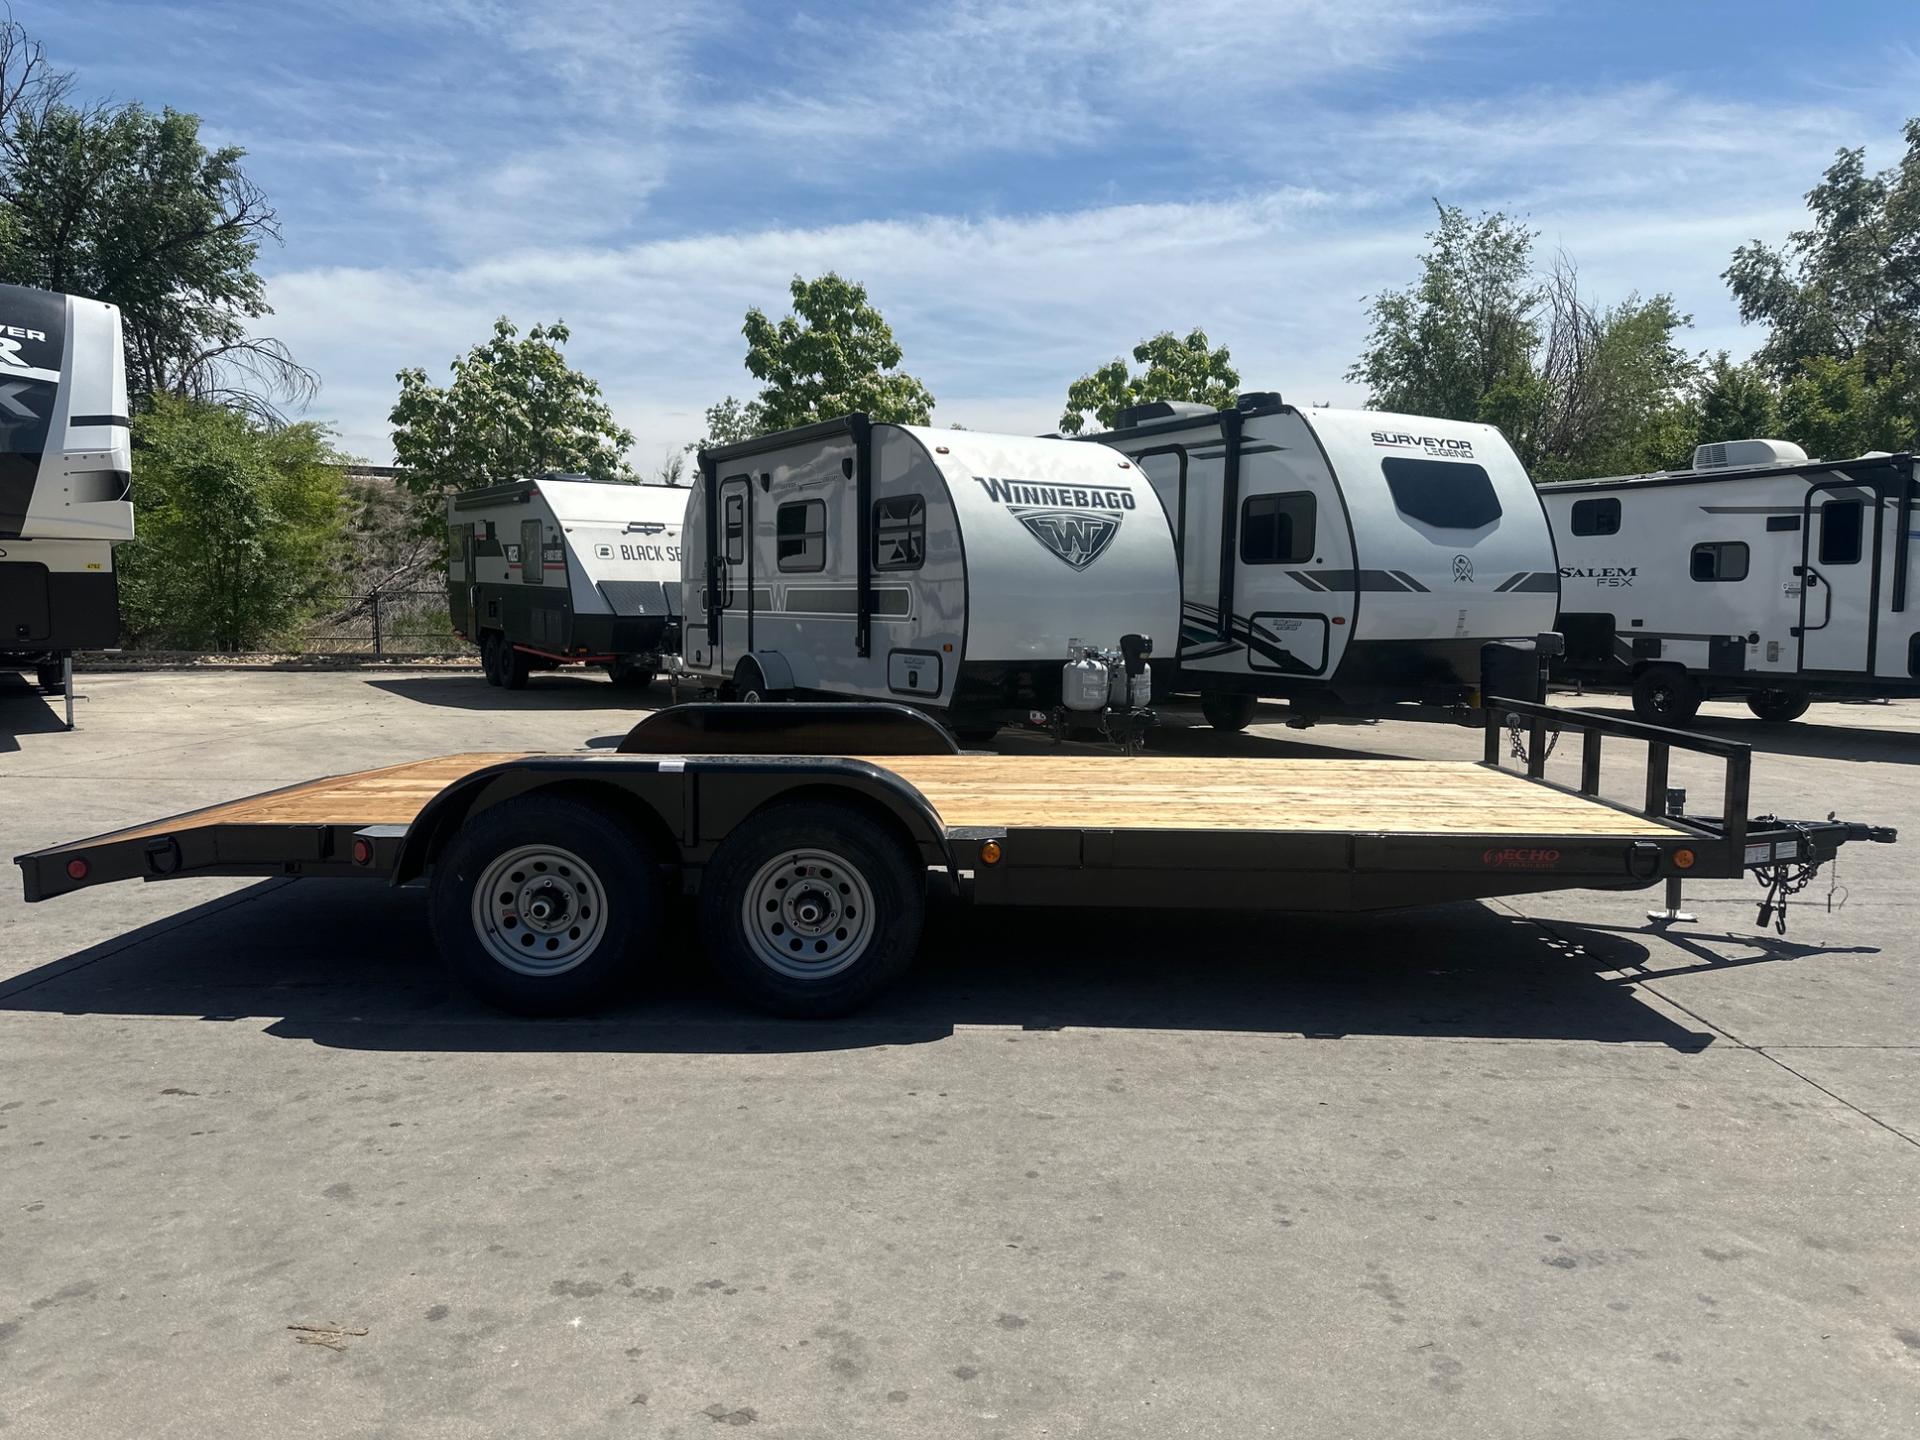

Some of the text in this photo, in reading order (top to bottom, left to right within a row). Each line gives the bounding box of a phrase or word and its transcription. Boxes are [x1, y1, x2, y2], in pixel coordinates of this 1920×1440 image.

[1371, 432, 1473, 450] SURVEYOR
[1423, 446, 1474, 459] LEGEND
[971, 476, 1137, 510] WINNEBAGO
[1034, 518, 1104, 555] W
[620, 544, 664, 562] BLACK
[1559, 566, 1639, 578] SALEM
[1597, 577, 1633, 587] FSX
[1503, 848, 1560, 862] ECHO
